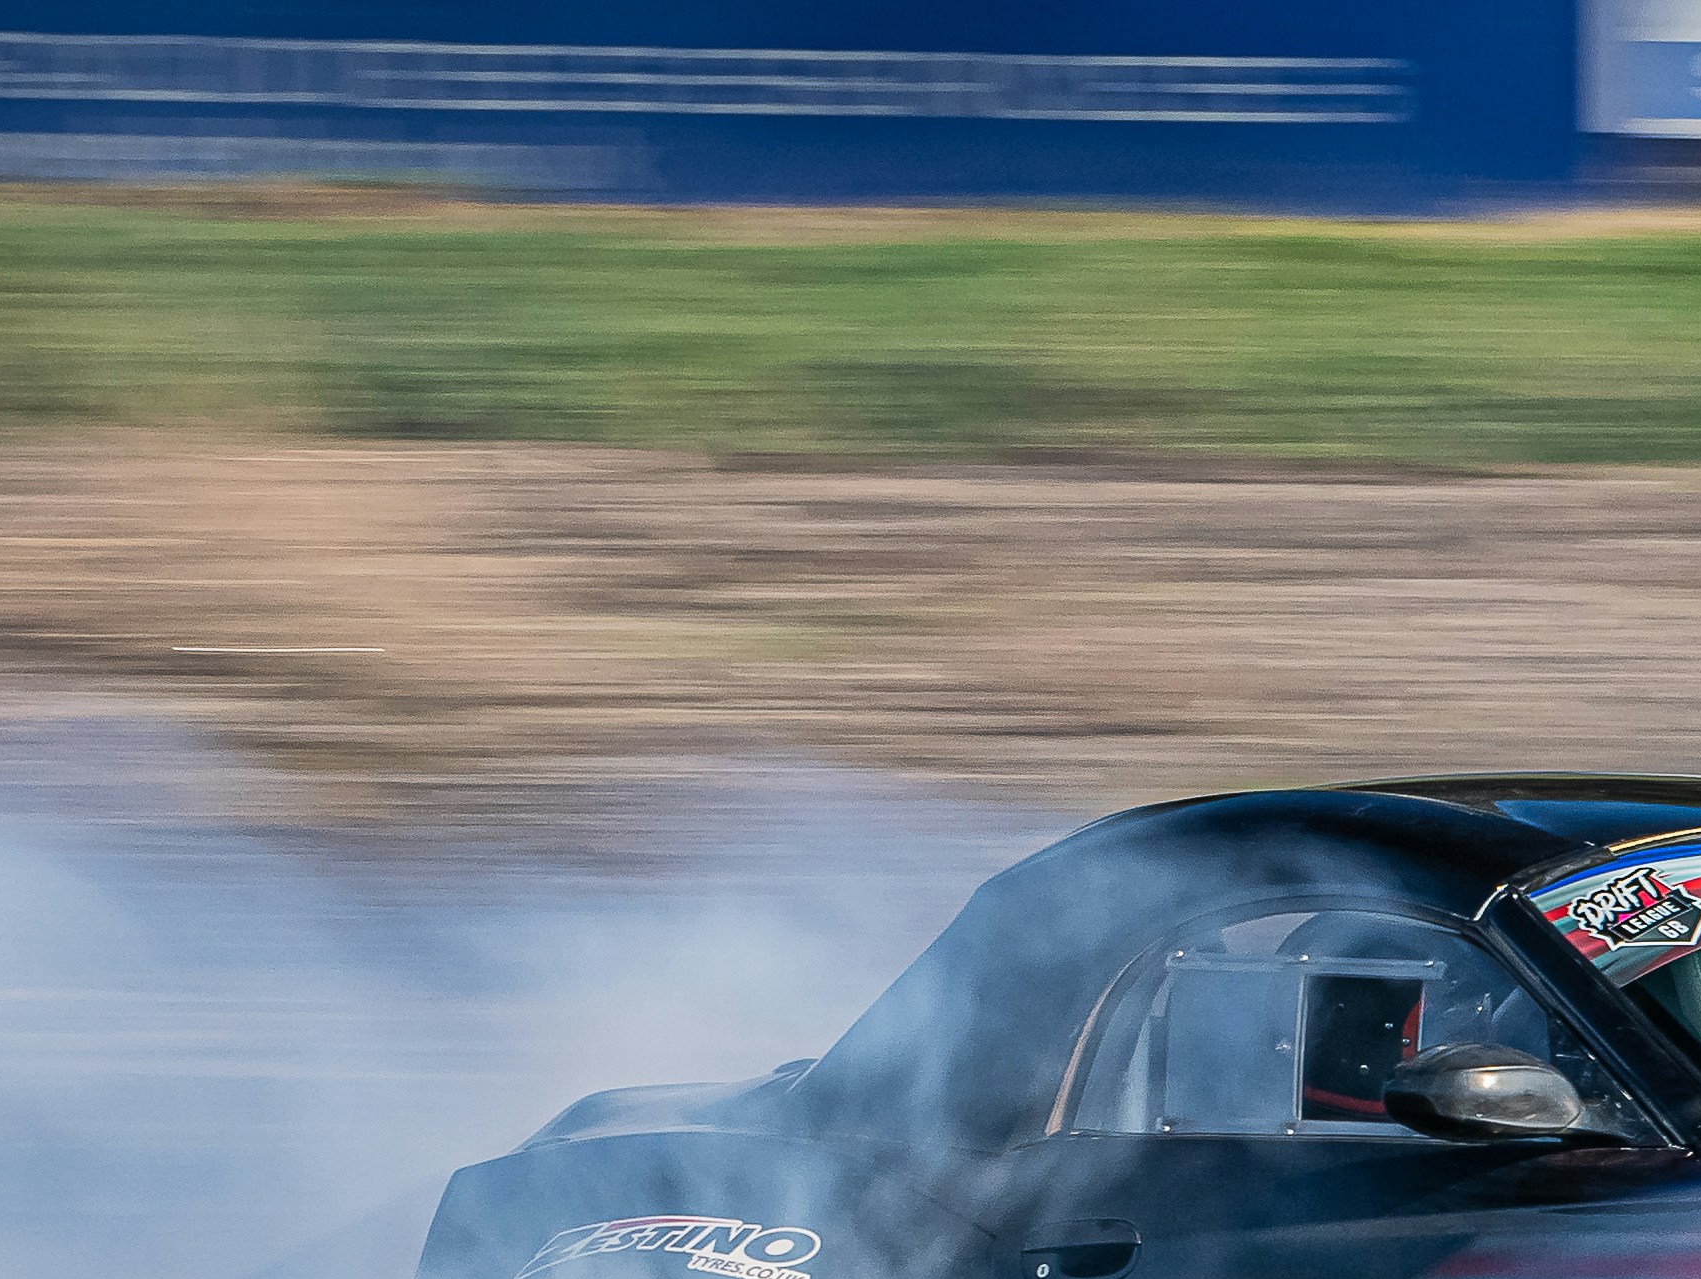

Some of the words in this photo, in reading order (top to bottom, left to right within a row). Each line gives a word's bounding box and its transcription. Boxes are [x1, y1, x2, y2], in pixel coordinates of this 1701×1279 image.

[1576, 868, 1658, 931] DRIFT
[1620, 900, 1682, 935] LEAGUE
[1656, 919, 1691, 940] GB
